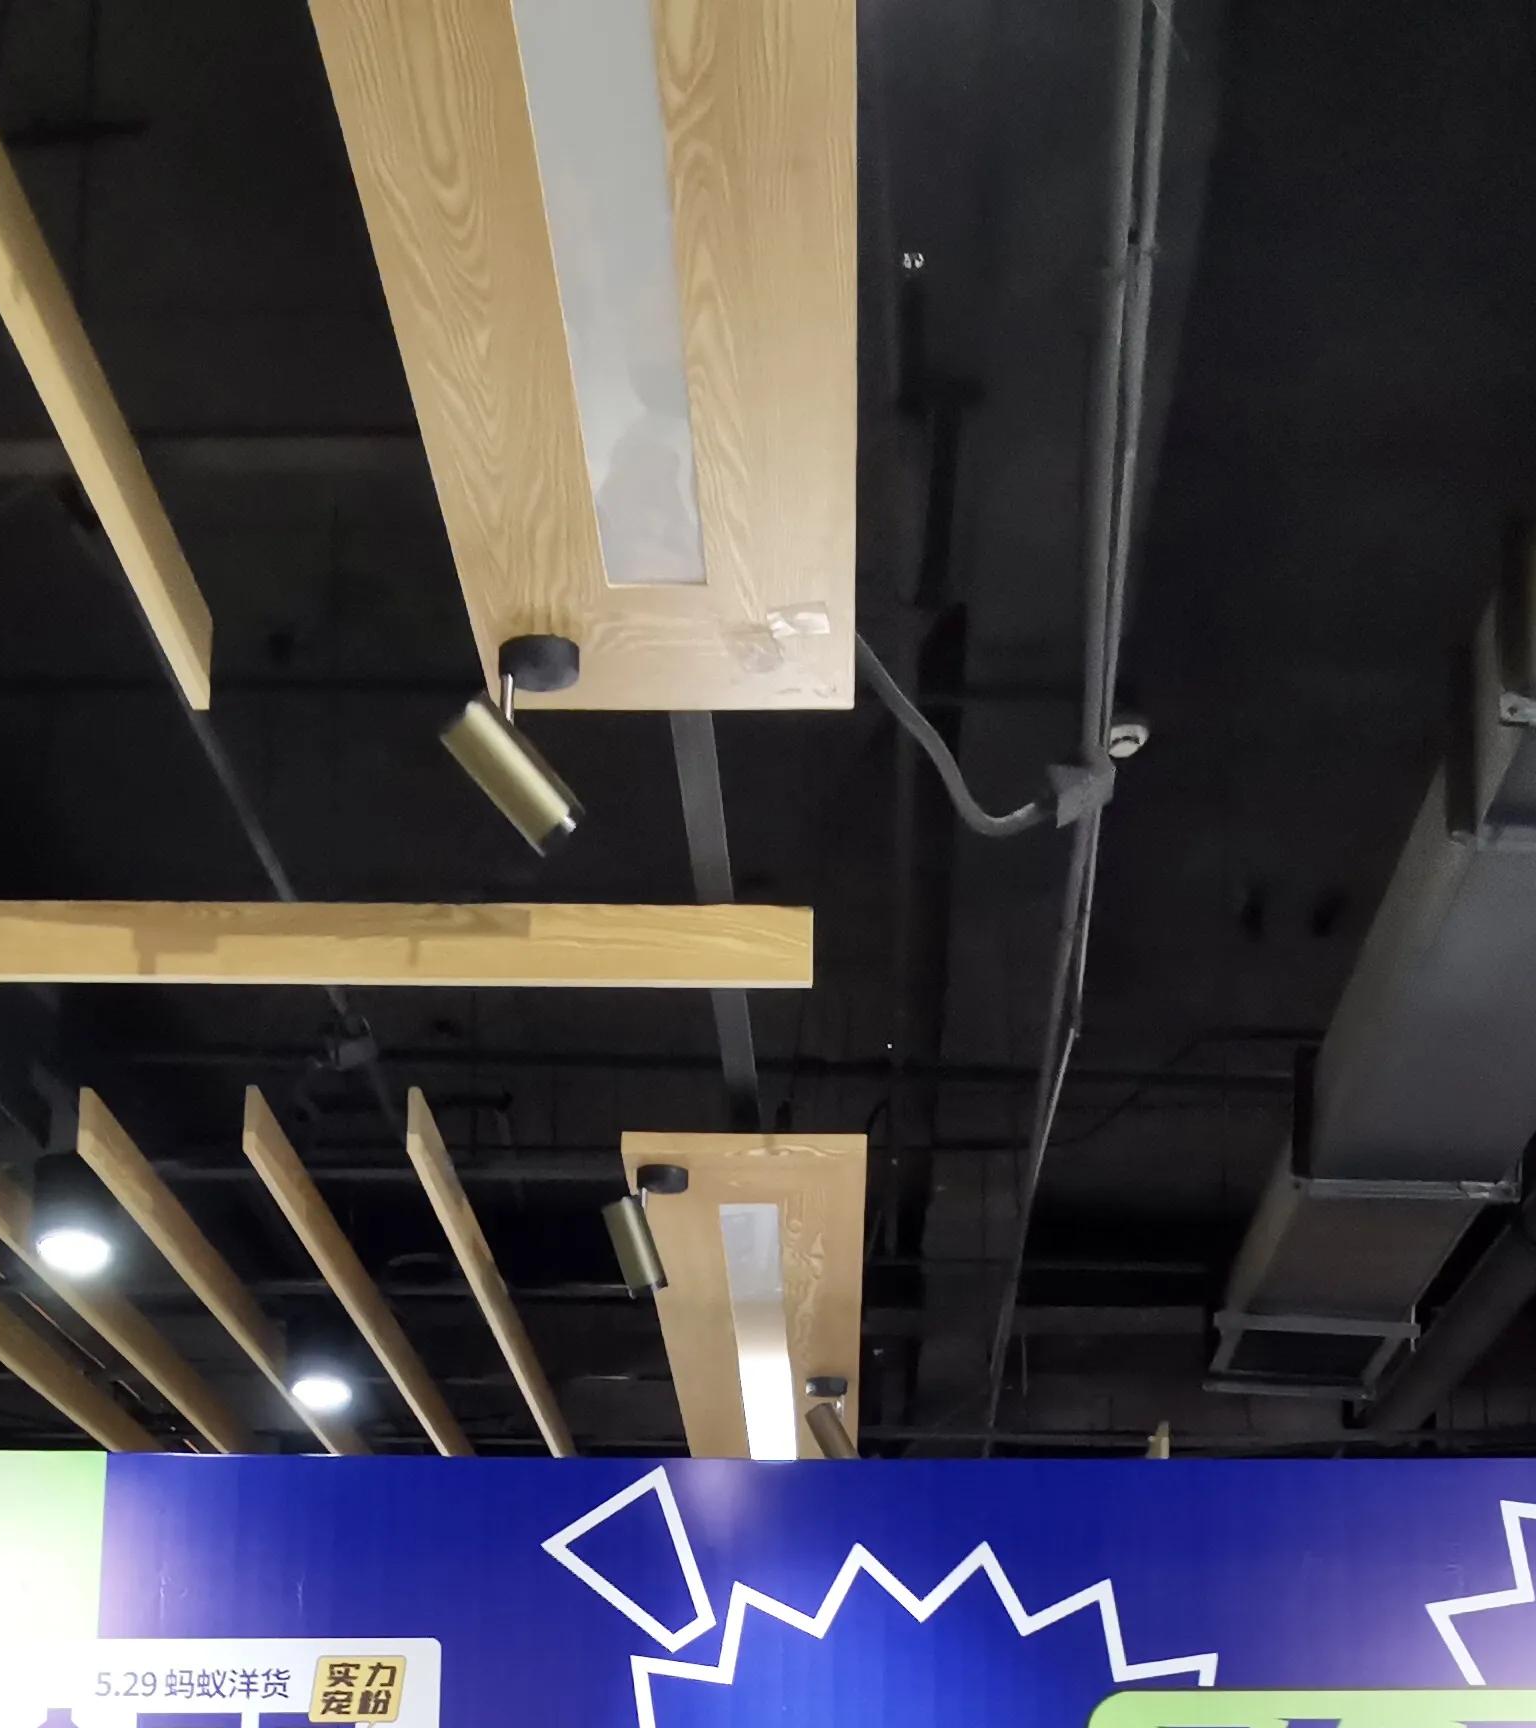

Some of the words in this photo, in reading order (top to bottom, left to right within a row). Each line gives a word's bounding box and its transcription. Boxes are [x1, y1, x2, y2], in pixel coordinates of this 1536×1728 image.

[93, 1671, 158, 1697] 5.29
[163, 1668, 292, 1700] 蚂蚁洋货
[327, 1661, 397, 1688] 实力
[321, 1688, 392, 1716] 宠粉
